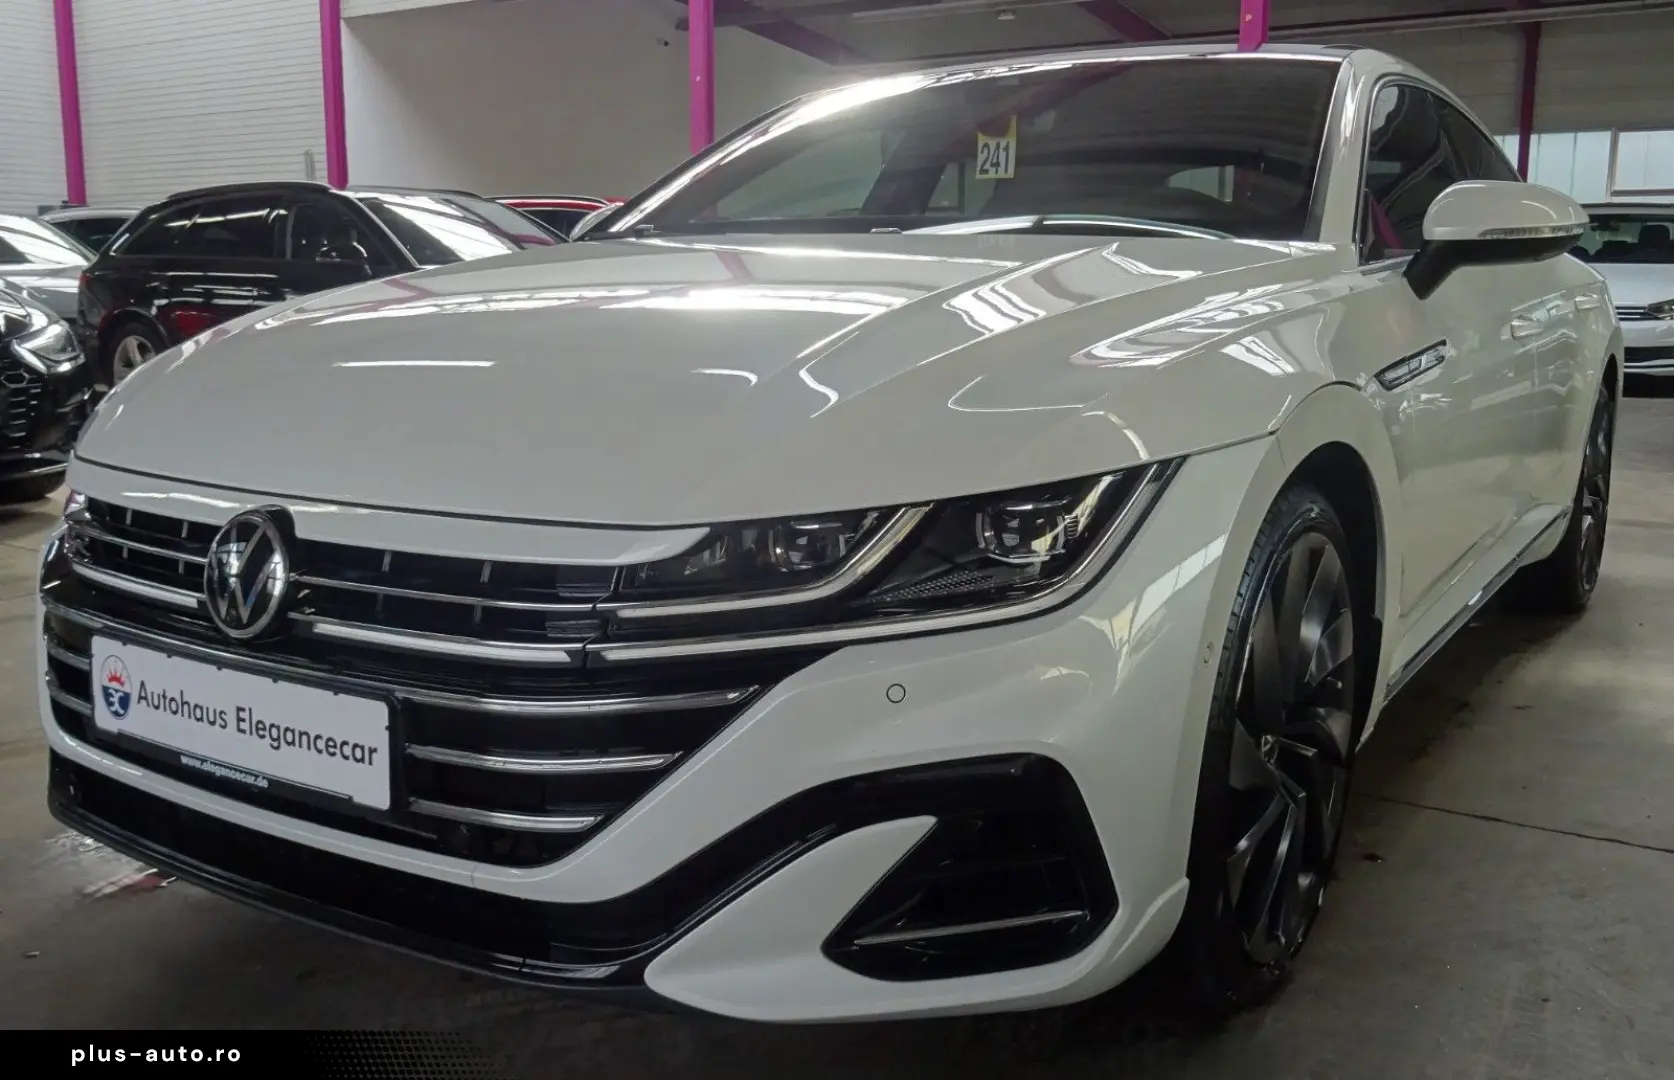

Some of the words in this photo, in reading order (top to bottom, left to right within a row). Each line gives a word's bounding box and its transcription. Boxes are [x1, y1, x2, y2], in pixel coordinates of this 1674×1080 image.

[979, 141, 1010, 175] 241
[137, 680, 228, 729] Autohaus
[236, 706, 378, 766] Elegancecar
[180, 755, 269, 788] www.elegancecar.de
